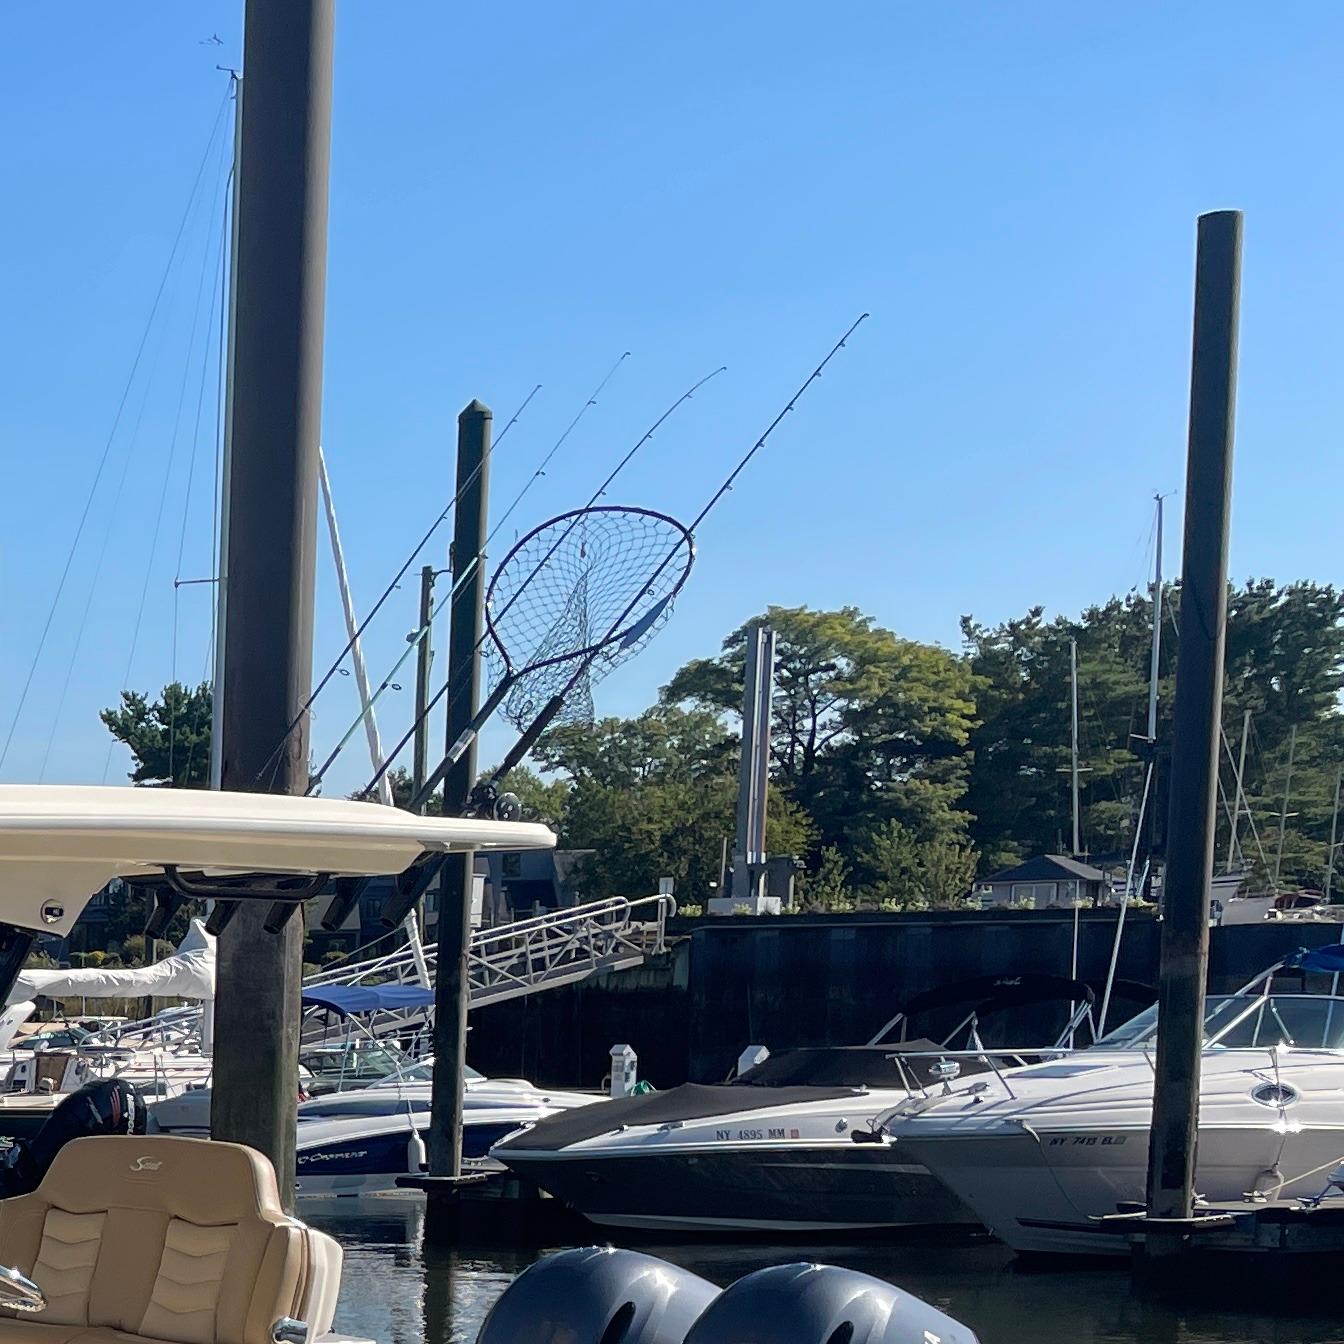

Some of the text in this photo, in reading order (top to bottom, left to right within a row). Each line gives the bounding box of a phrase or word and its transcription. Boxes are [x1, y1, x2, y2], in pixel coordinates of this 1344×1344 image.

[716, 1130, 731, 1140] NY
[737, 1129, 763, 1139] 4895
[768, 1128, 786, 1139] MM
[1049, 1137, 1068, 1146] NY
